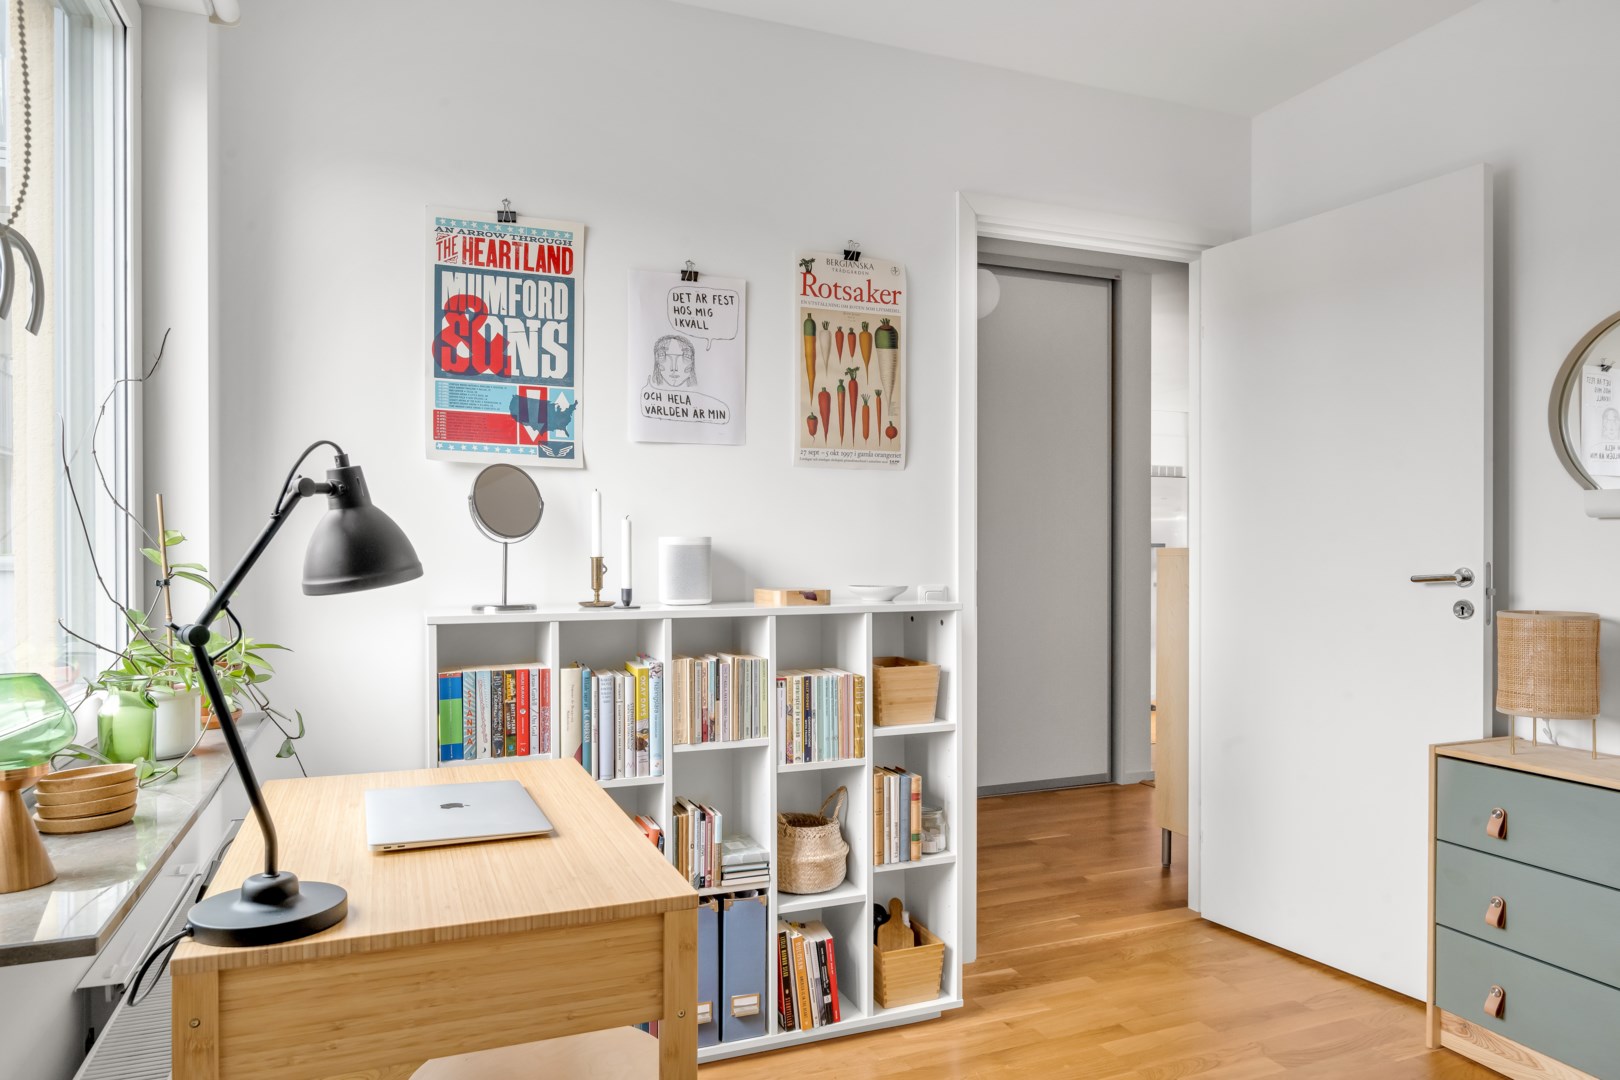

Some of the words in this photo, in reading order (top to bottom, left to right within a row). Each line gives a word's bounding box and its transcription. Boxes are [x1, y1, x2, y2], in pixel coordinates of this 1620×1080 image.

[434, 225, 454, 234] AN
[457, 228, 508, 239] ARROW
[509, 234, 573, 247] THROUGH
[436, 234, 458, 263] THE
[462, 236, 574, 275] HEARTLAND
[826, 258, 874, 271] BERGIANSKA
[441, 270, 569, 320] MUMFORD
[672, 292, 692, 304] DET
[695, 290, 708, 304] ÄR
[712, 294, 734, 306] FEST
[800, 271, 902, 306] Rotsaker
[673, 305, 692, 315] HOS
[695, 307, 713, 318] MIG
[441, 312, 568, 380] SONS
[643, 391, 662, 402] OCH
[667, 393, 692, 406] HELA
[644, 403, 689, 417] VÄRLDEN
[692, 406, 705, 419] ÄR
[708, 409, 726, 420] MIN
[466, 690, 474, 746] STANNA
[795, 941, 804, 970] BULOSAN
